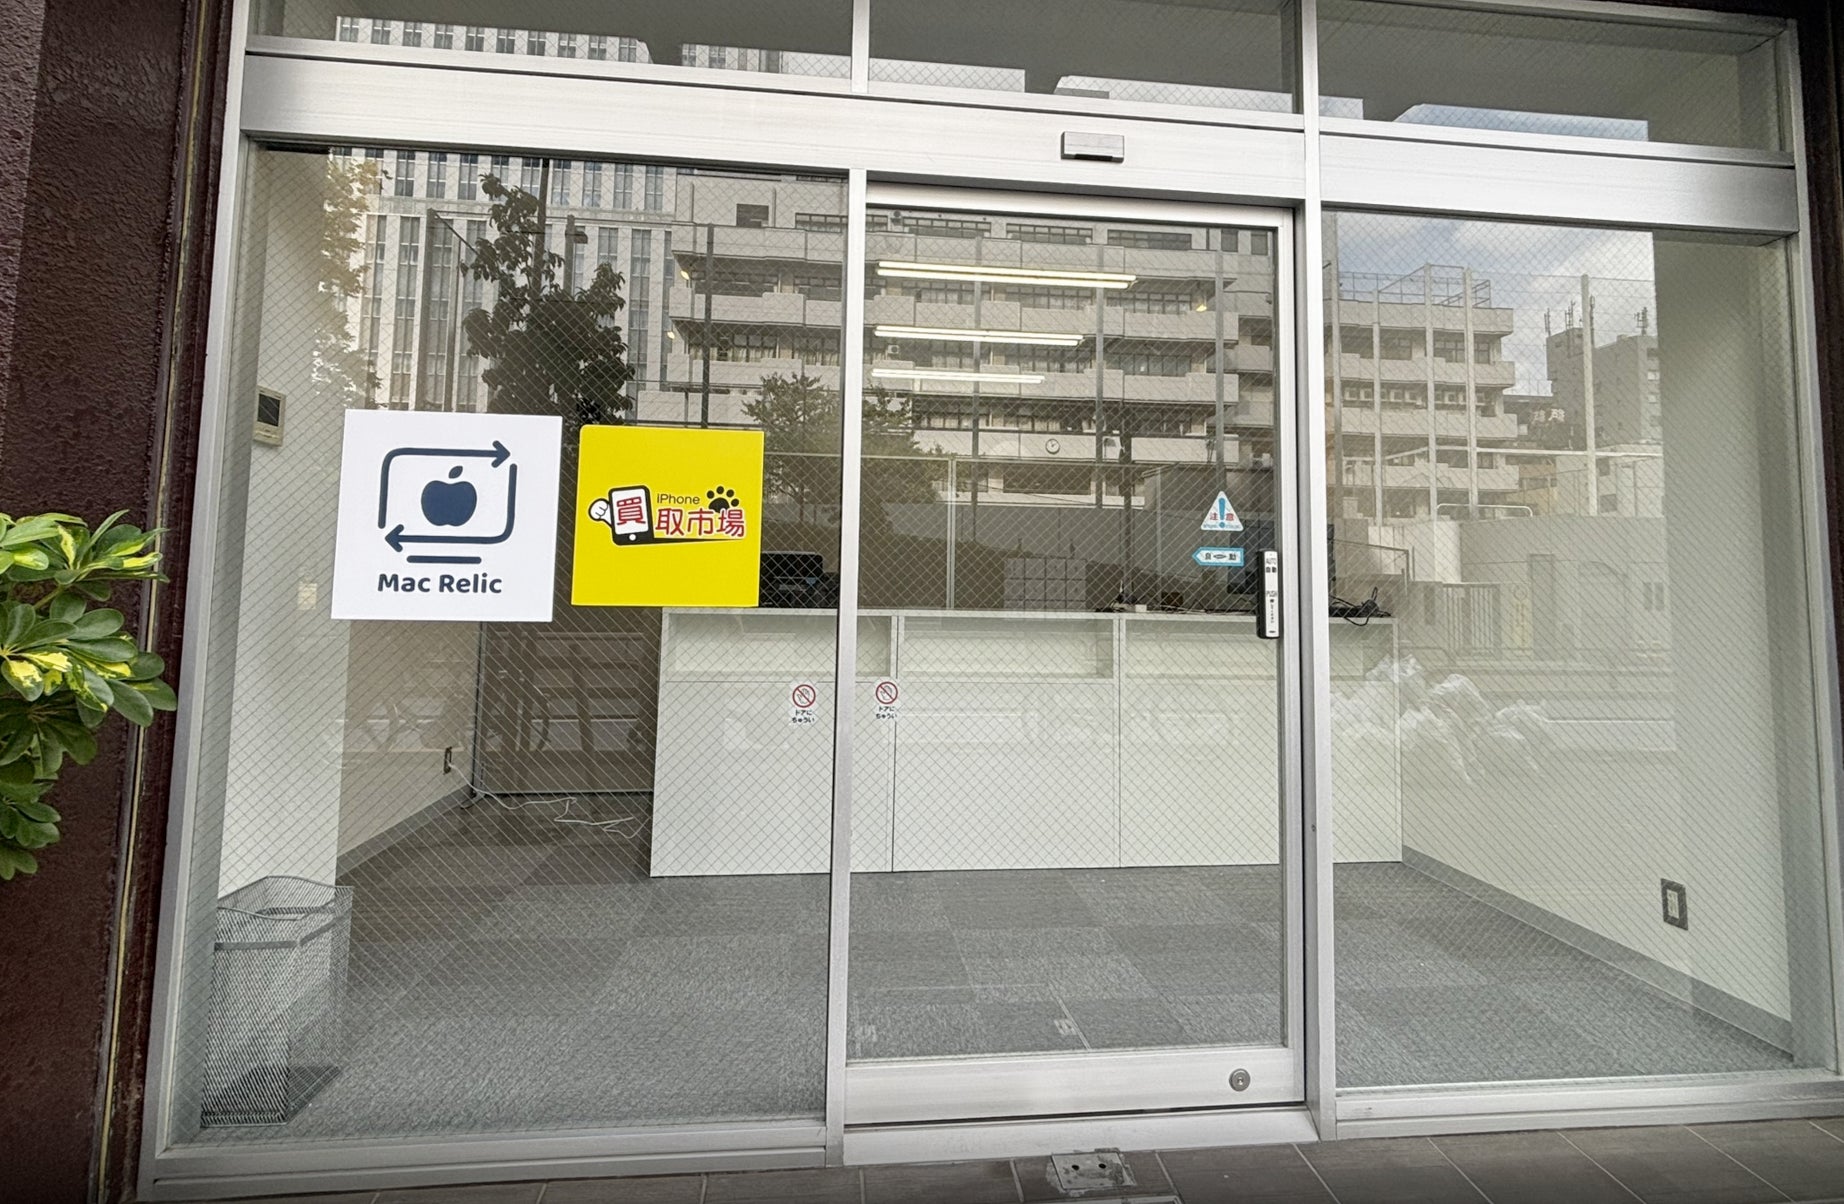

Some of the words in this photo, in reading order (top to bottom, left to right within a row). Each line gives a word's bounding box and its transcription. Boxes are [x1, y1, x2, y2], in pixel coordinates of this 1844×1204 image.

[657, 493, 700, 505] iPhone
[617, 496, 745, 537] 買取市場
[377, 573, 431, 593] Mac
[439, 572, 503, 594] Relic
